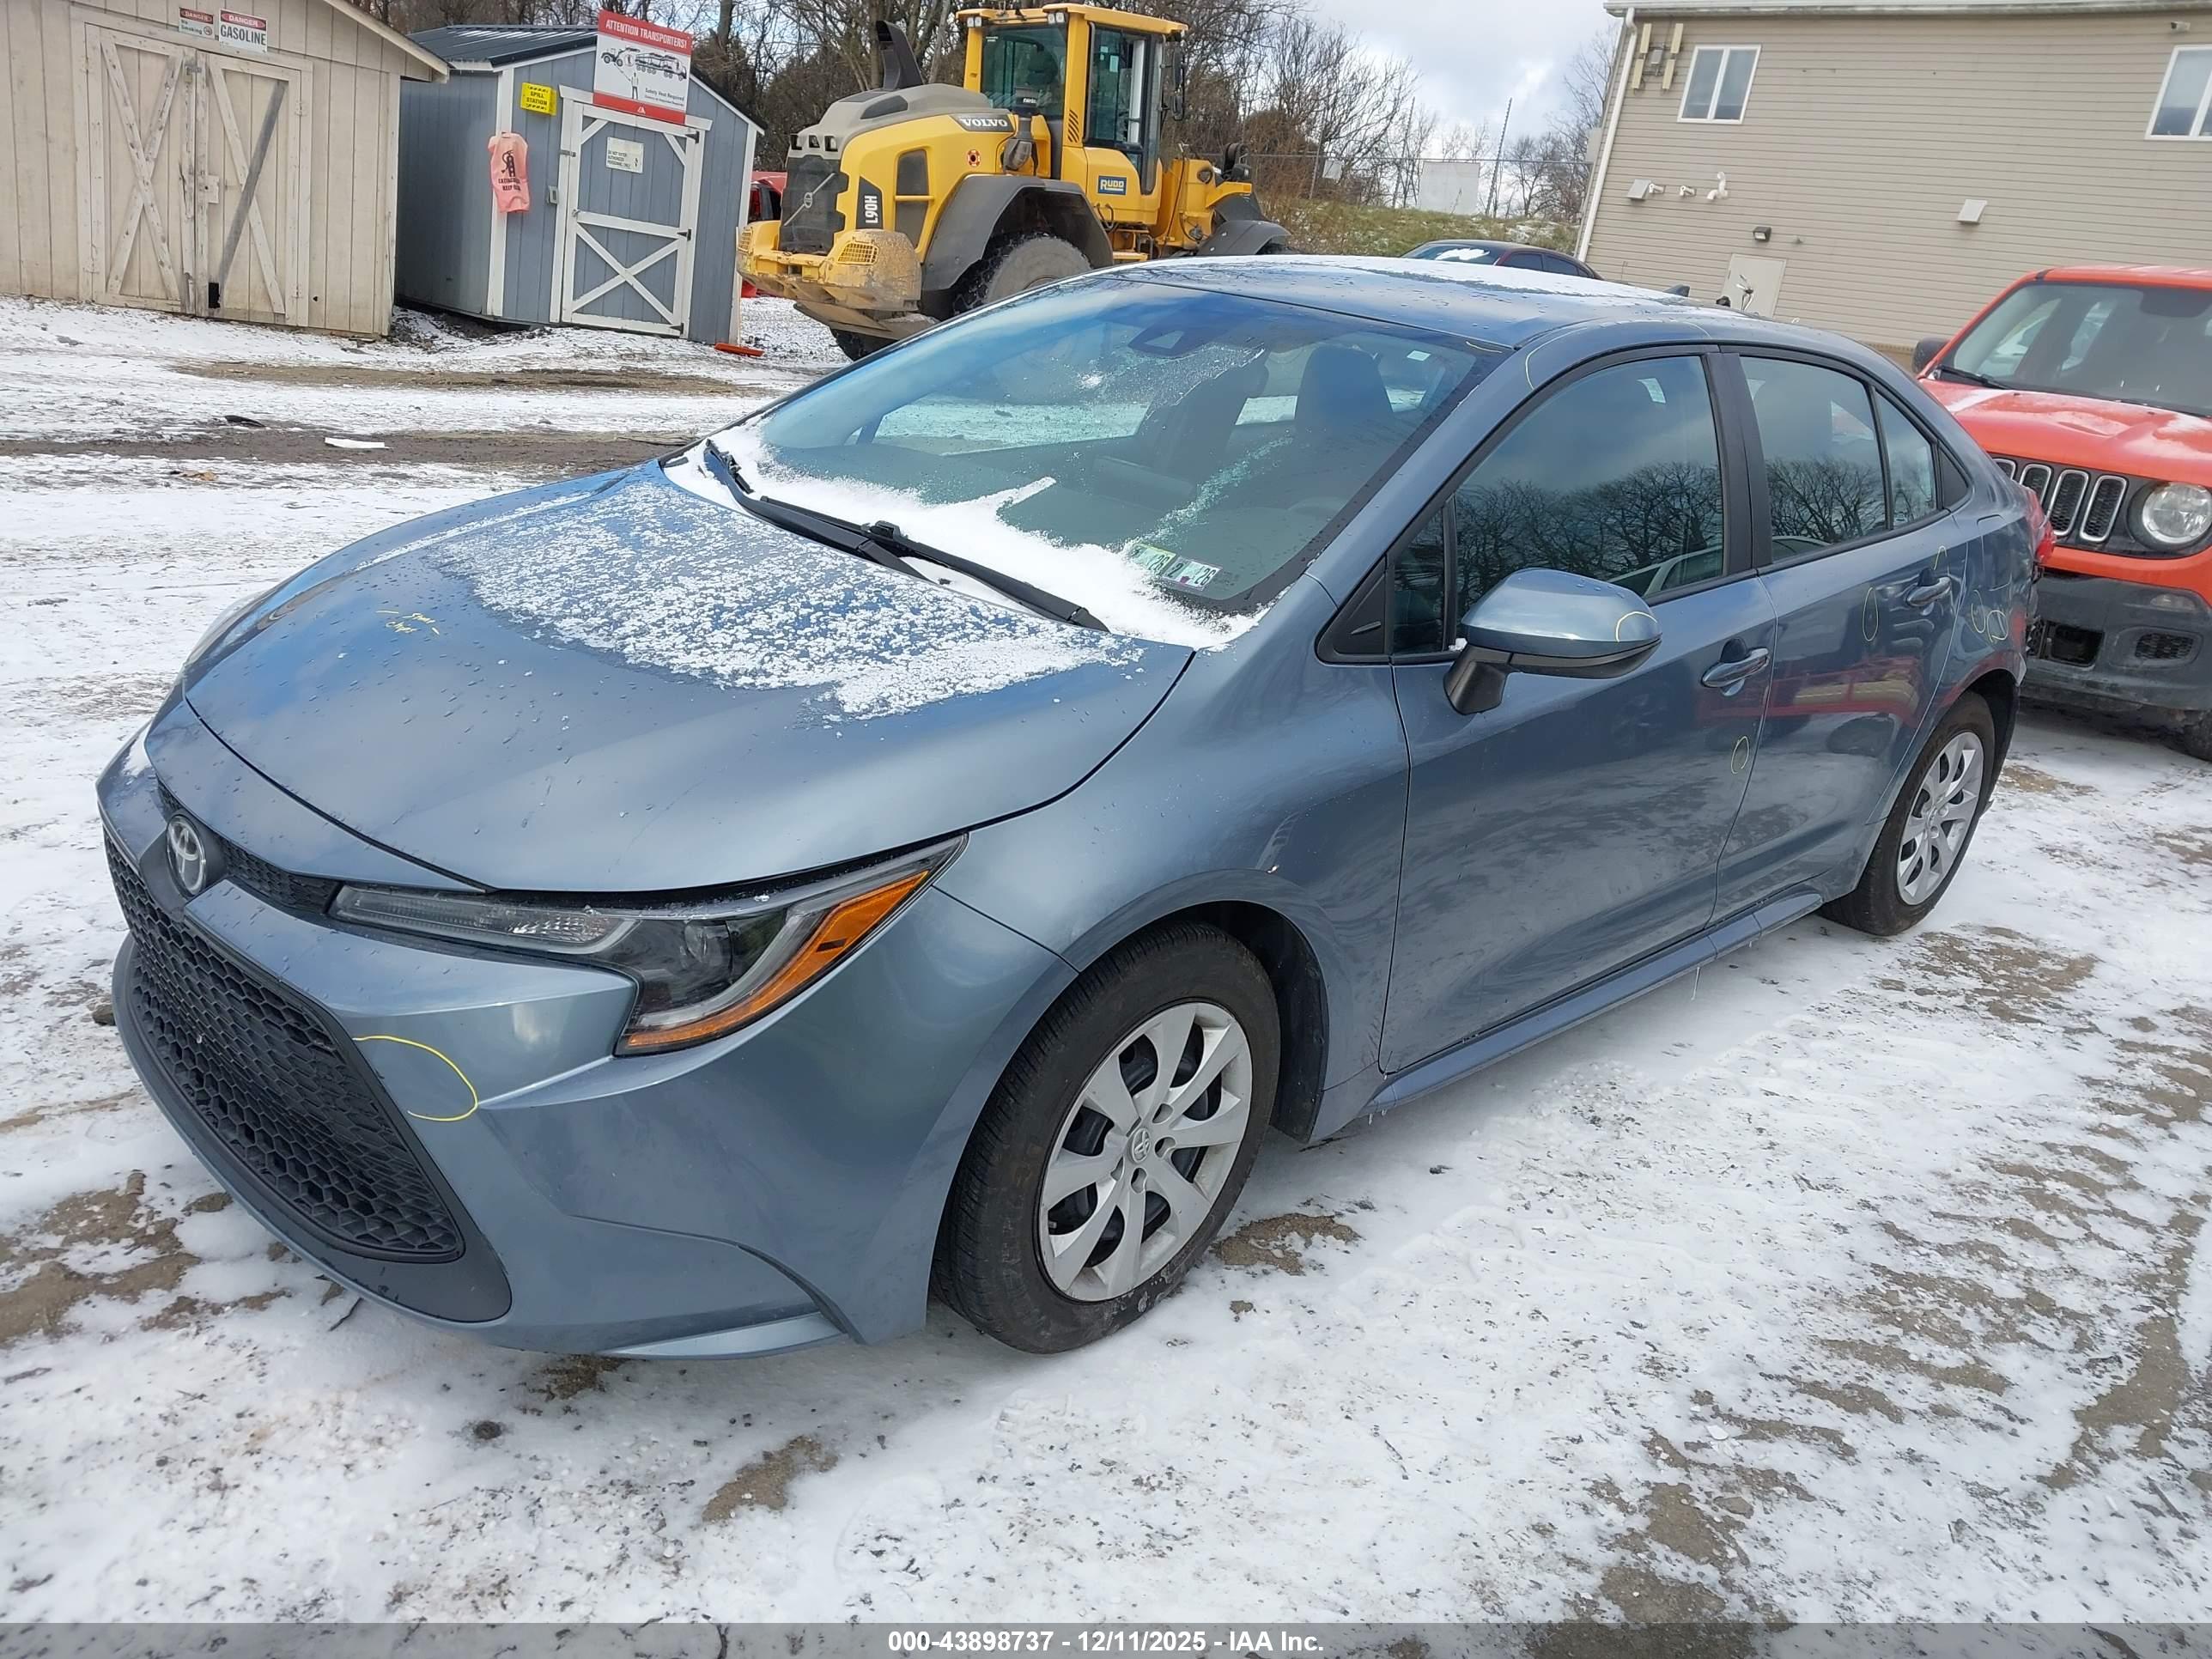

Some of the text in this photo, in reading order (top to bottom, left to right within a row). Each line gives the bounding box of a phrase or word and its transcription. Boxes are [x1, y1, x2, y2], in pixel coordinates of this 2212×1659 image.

[185, 10, 208, 21] DANGER
[228, 15, 258, 27] DANGER
[220, 24, 266, 46] GASOLINE
[605, 19, 687, 49] ATTENTION TRANSPORTERS!
[960, 118, 1008, 127] VOLVO
[1100, 179, 1124, 191] RUDD
[864, 195, 878, 223] L90H
[1194, 568, 1217, 586] 26
